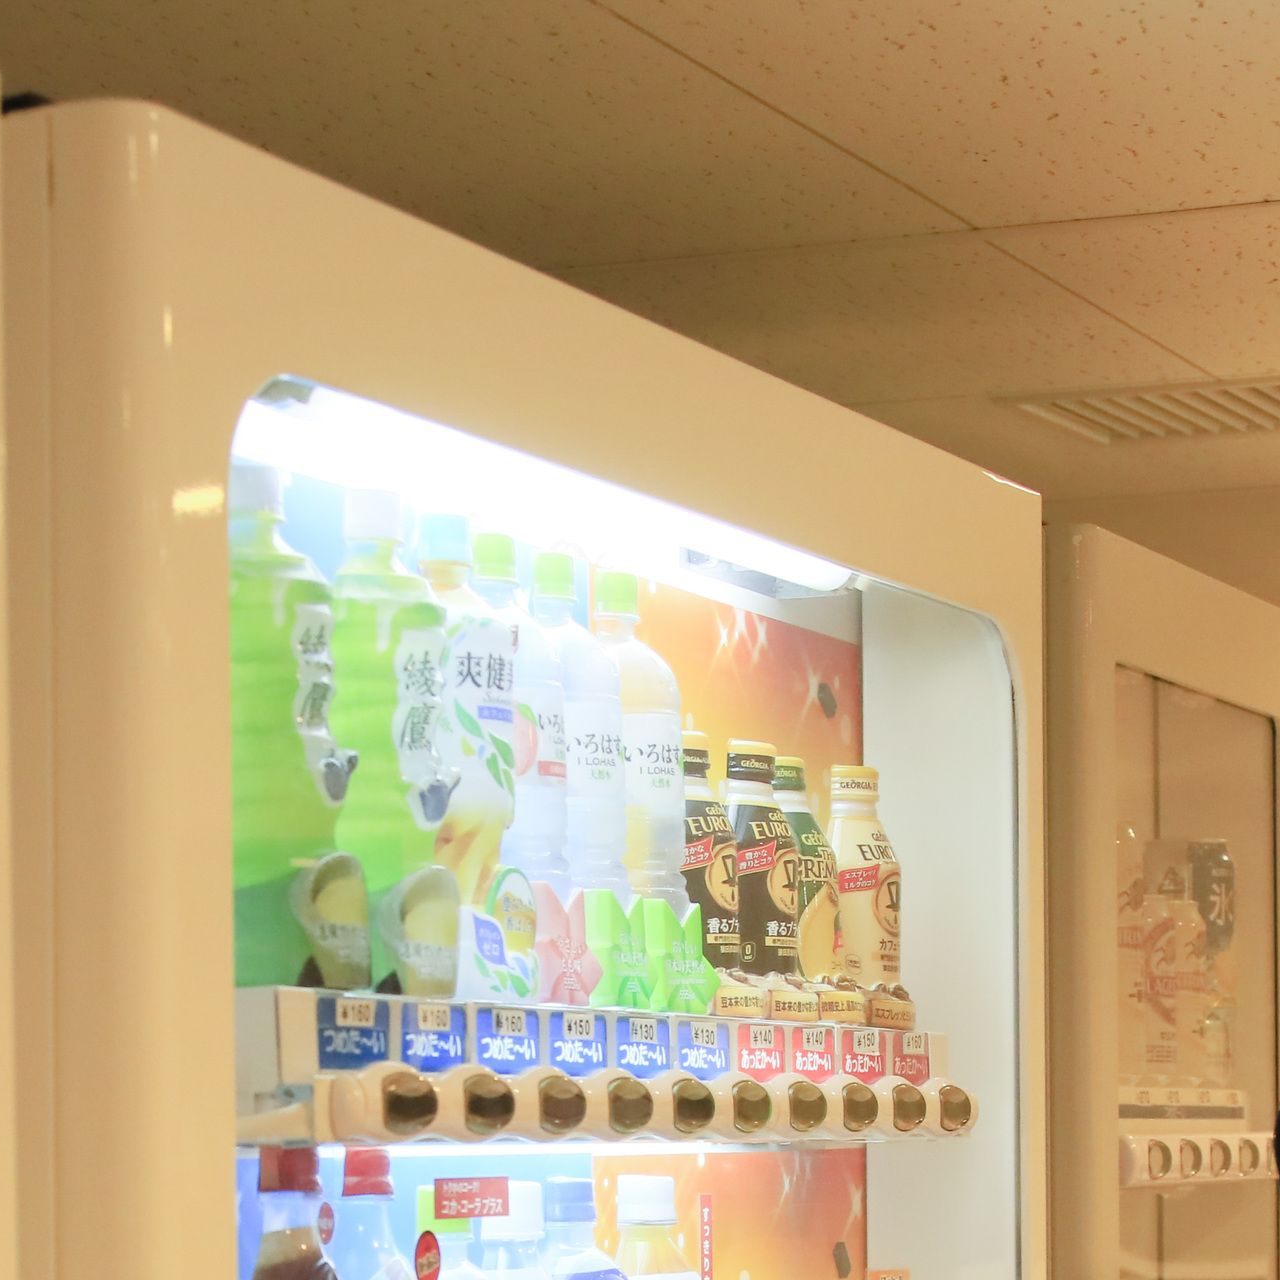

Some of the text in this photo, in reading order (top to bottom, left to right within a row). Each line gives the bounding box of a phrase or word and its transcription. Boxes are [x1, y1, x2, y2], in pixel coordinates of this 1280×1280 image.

[538, 714, 564, 735] いろ
[585, 757, 616, 768] LOHAS
[741, 758, 769, 770] GEORGIA
[647, 767, 676, 776] LOHAS
[840, 779, 872, 790] GEORGIA
[749, 821, 791, 840] EURO
[567, 1020, 590, 1036] ¥150
[694, 1027, 715, 1045] ¥130
[753, 1031, 772, 1046] ¥140
[806, 1031, 823, 1046] ¥140
[857, 1032, 875, 1047] ¥150
